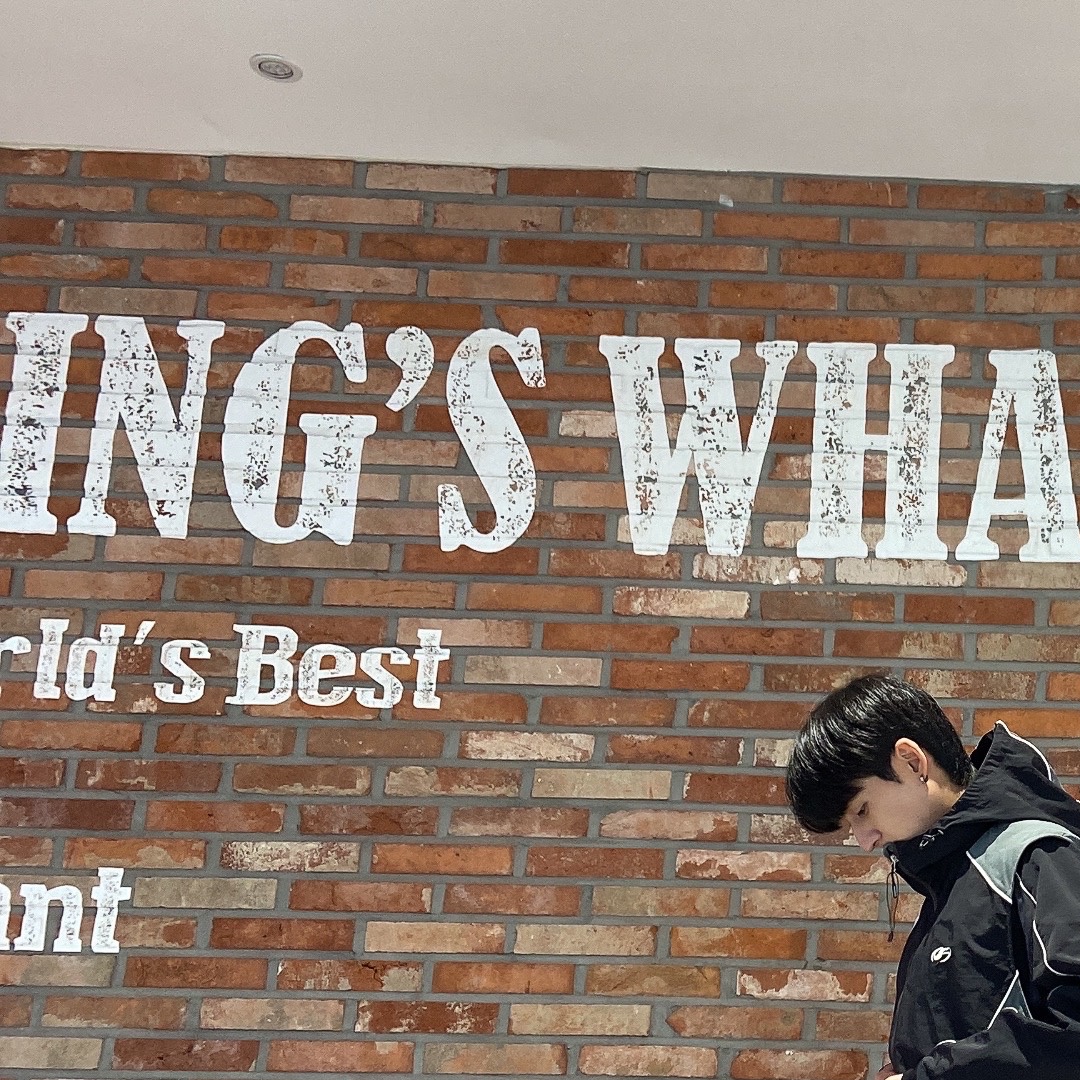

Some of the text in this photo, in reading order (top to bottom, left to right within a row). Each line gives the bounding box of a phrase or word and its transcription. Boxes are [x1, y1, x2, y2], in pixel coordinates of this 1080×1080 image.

[0, 312, 547, 553] ING'S
[225, 623, 451, 709] Best
[0, 866, 132, 953] nt
